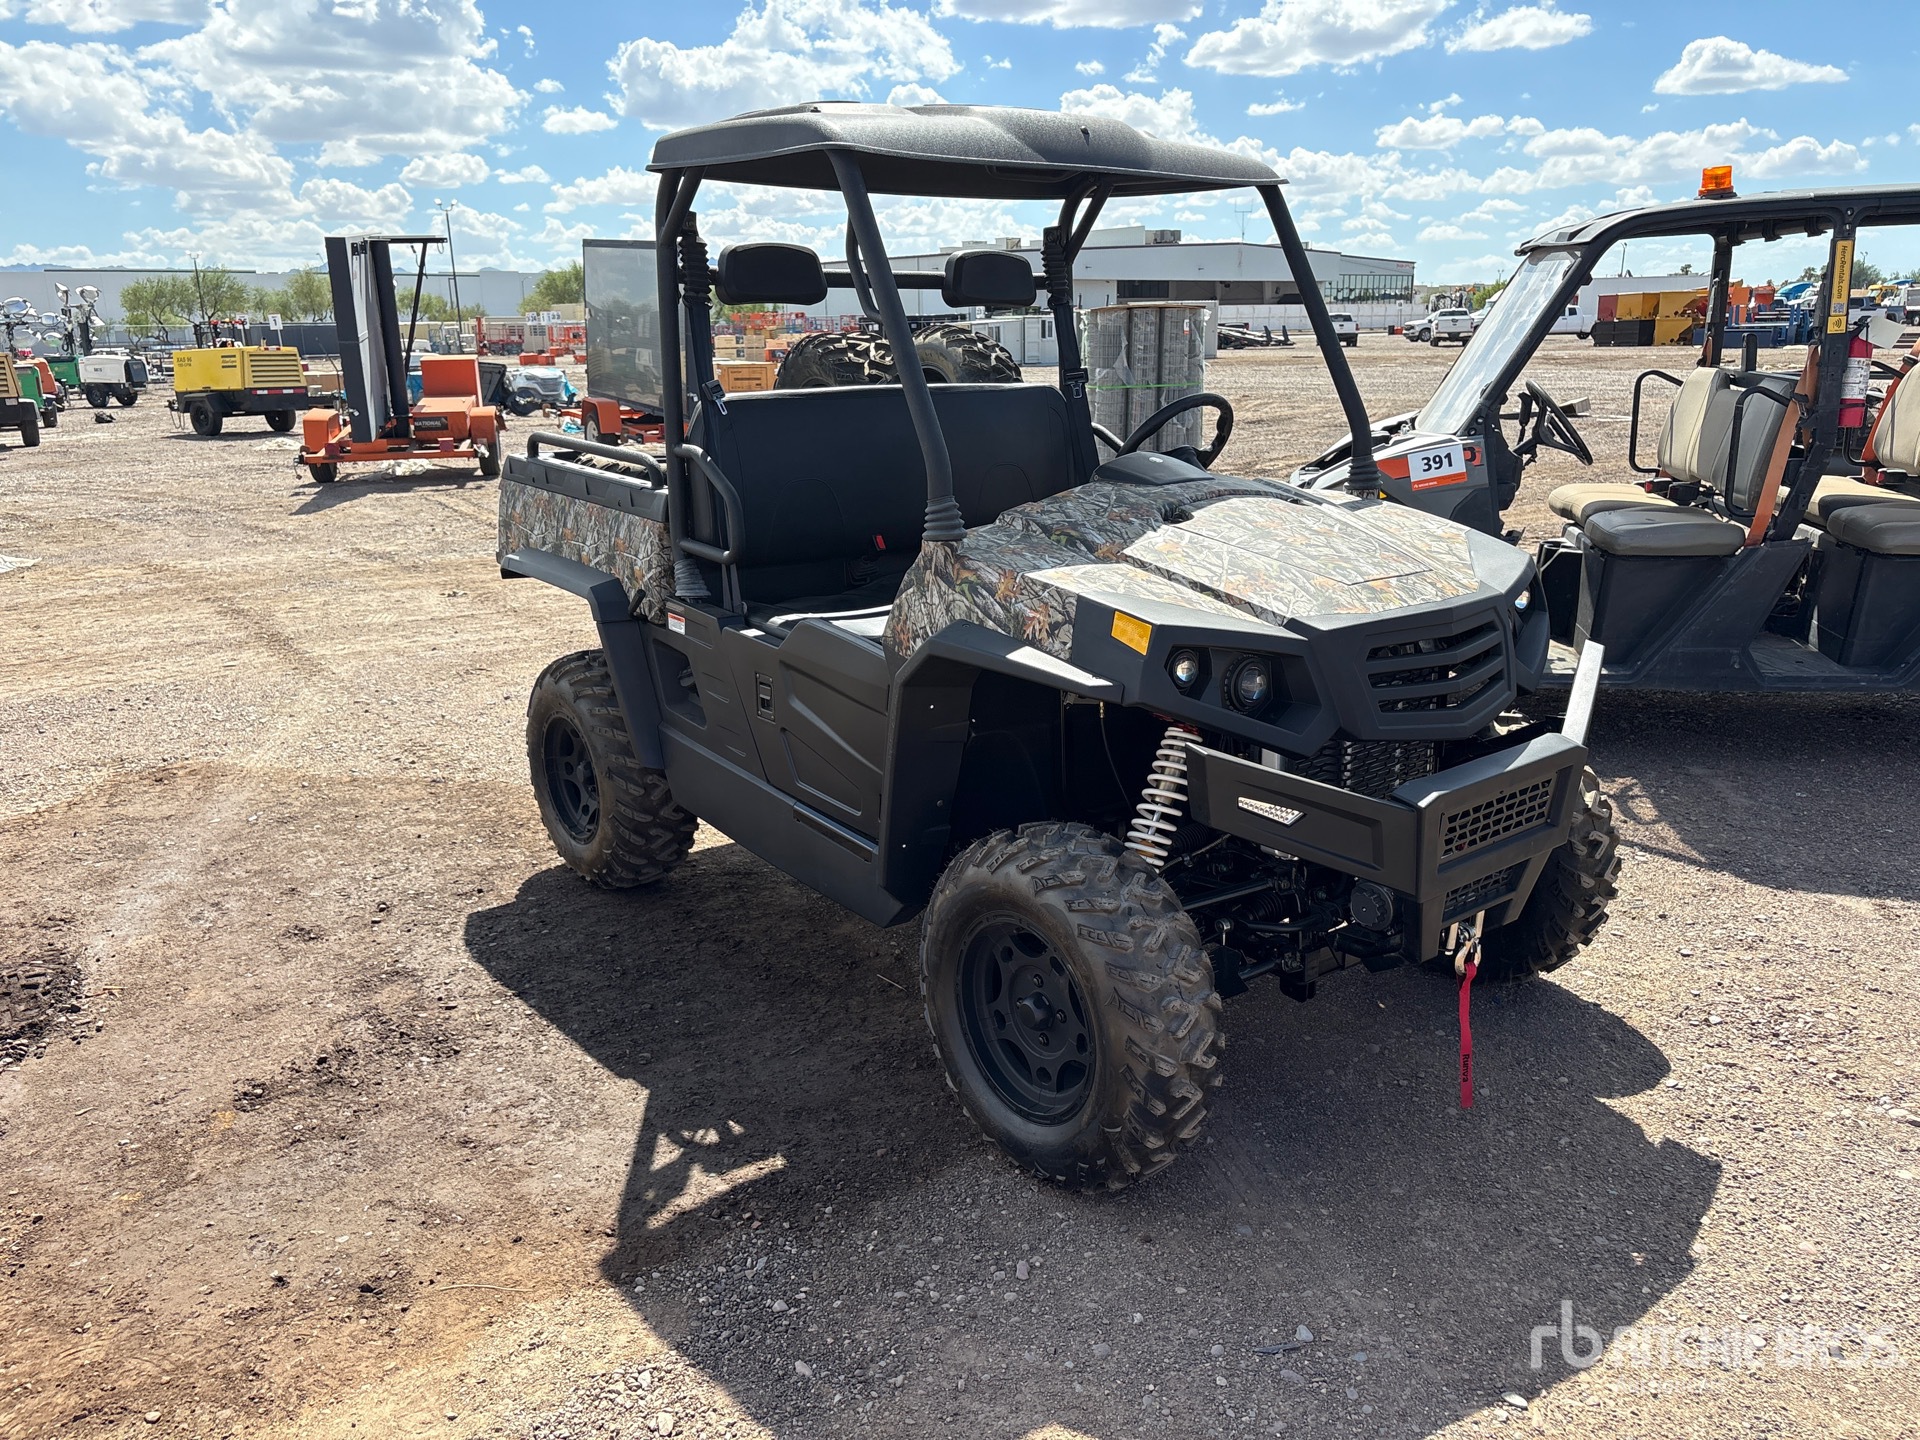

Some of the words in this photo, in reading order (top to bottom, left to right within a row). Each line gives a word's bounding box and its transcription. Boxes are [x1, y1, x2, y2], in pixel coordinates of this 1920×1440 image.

[1836, 245, 1848, 299] HercRentals.com
[1421, 452, 1453, 472] 391
[1462, 1053, 1470, 1083] Runva
